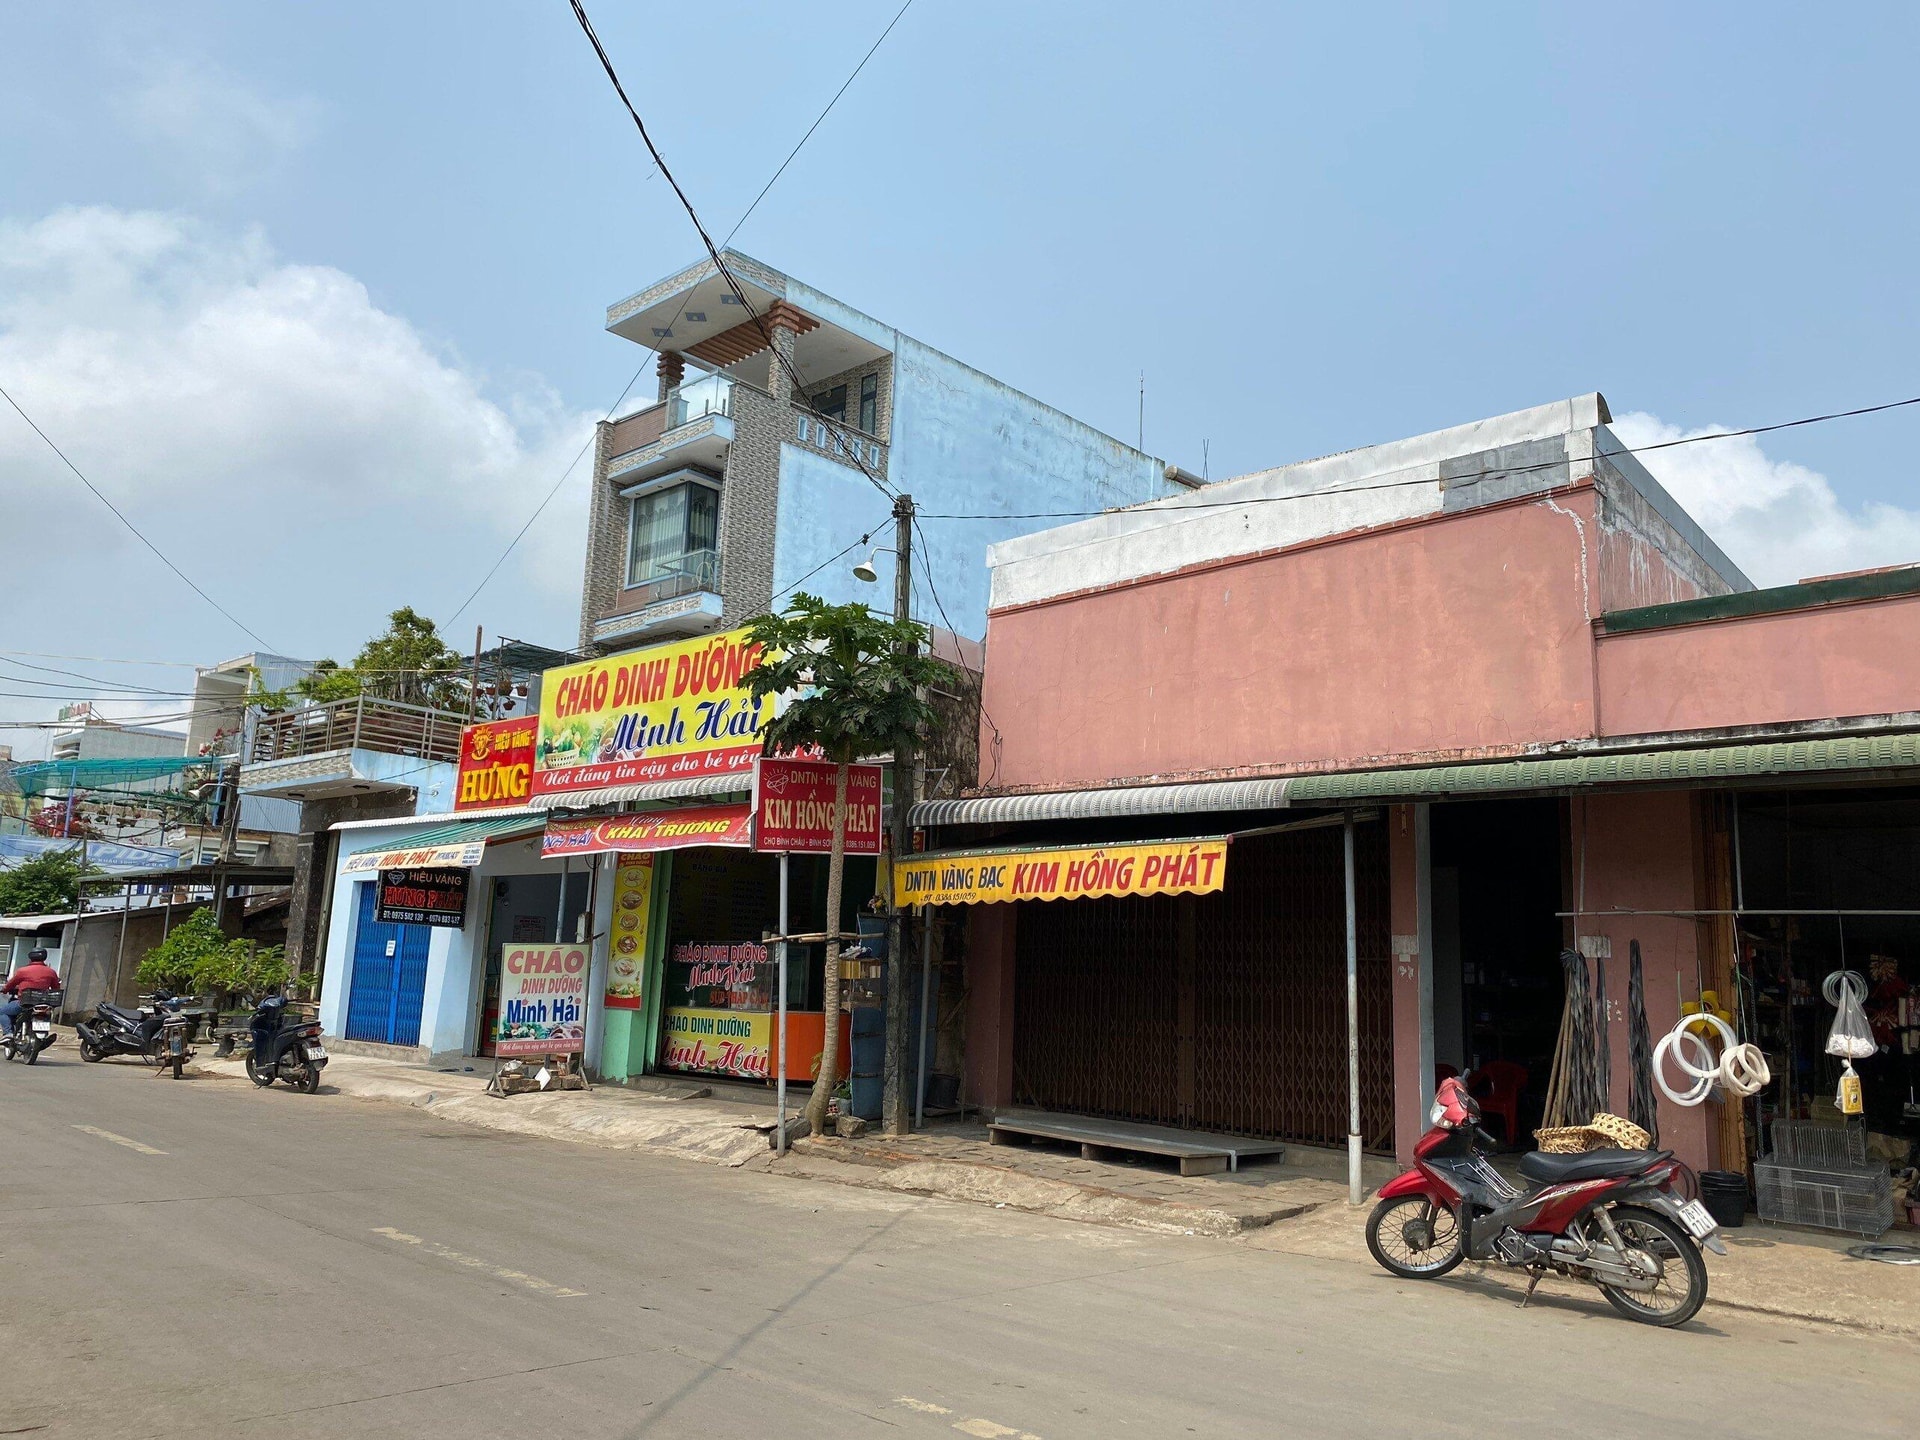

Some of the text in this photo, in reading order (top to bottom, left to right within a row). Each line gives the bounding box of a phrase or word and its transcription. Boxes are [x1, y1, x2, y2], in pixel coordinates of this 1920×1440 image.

[555, 666, 609, 719] CHÁO
[612, 655, 671, 709] DINH
[605, 696, 762, 752] Minh Hải
[574, 767, 611, 783] đáng
[640, 761, 667, 779] cậy
[672, 756, 700, 772] cho
[704, 752, 723, 768] bé
[790, 770, 818, 785] DNTN
[850, 771, 877, 789] VÀNG
[763, 798, 792, 830] KIM
[604, 826, 651, 840] KHAI
[406, 848, 438, 865] PHÁT
[905, 845, 1221, 895] DNTN VÀNG BẠC KIM HỒNG PHÁT
[409, 870, 462, 886] HIỆU VÀNG
[507, 947, 585, 975] CHÁO
[730, 941, 768, 964] DƯỠNG
[521, 974, 583, 995] DINH DƯỠNG
[685, 962, 722, 992] Minh
[507, 995, 582, 1024] Minh Hải
[663, 1012, 751, 1038] CHÁO DINH DƯỠNG
[717, 1039, 769, 1073] Hải
